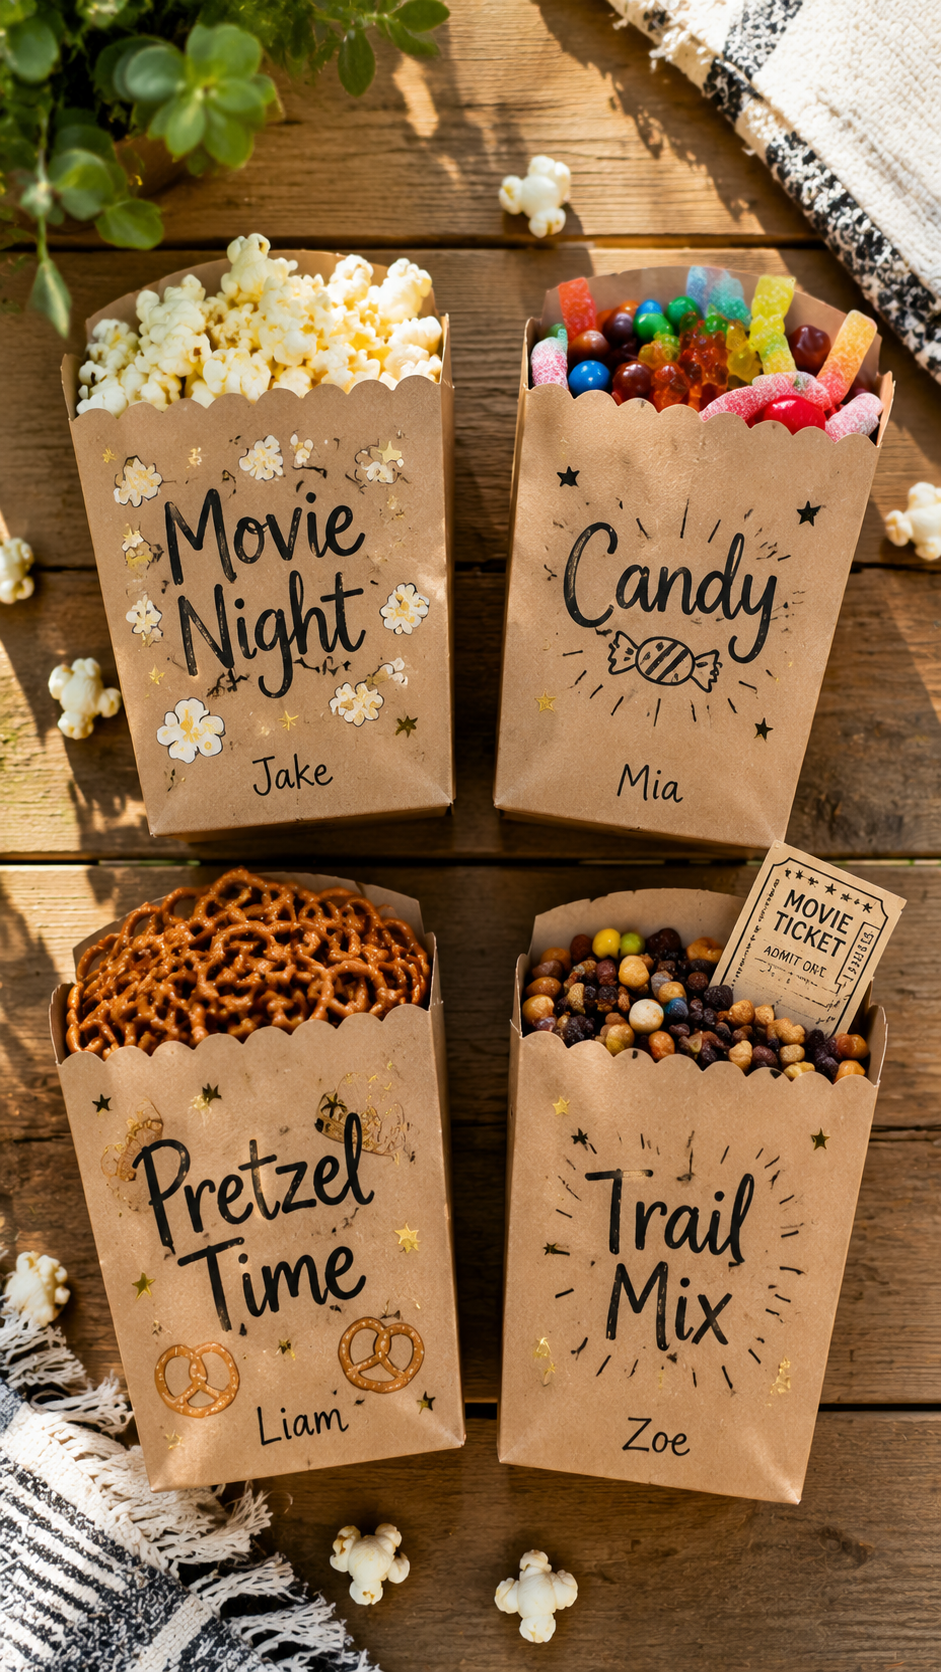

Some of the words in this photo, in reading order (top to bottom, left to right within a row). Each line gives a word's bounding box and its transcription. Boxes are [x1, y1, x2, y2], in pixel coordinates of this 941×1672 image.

[164, 489, 366, 585] Movie
[563, 522, 777, 664] Candy
[178, 570, 367, 698] Night
[252, 753, 333, 796] Jake
[617, 764, 683, 803] Mia
[773, 911, 846, 957] TICKET
[783, 889, 853, 935] MOVIE
[763, 945, 802, 966] ADMIT
[132, 1112, 375, 1254] Pretzel
[585, 1168, 754, 1263] Trail
[177, 1237, 367, 1332] Time
[606, 1261, 733, 1351] Mix
[257, 1406, 349, 1446] Liam
[622, 1417, 690, 1456] Zoe
